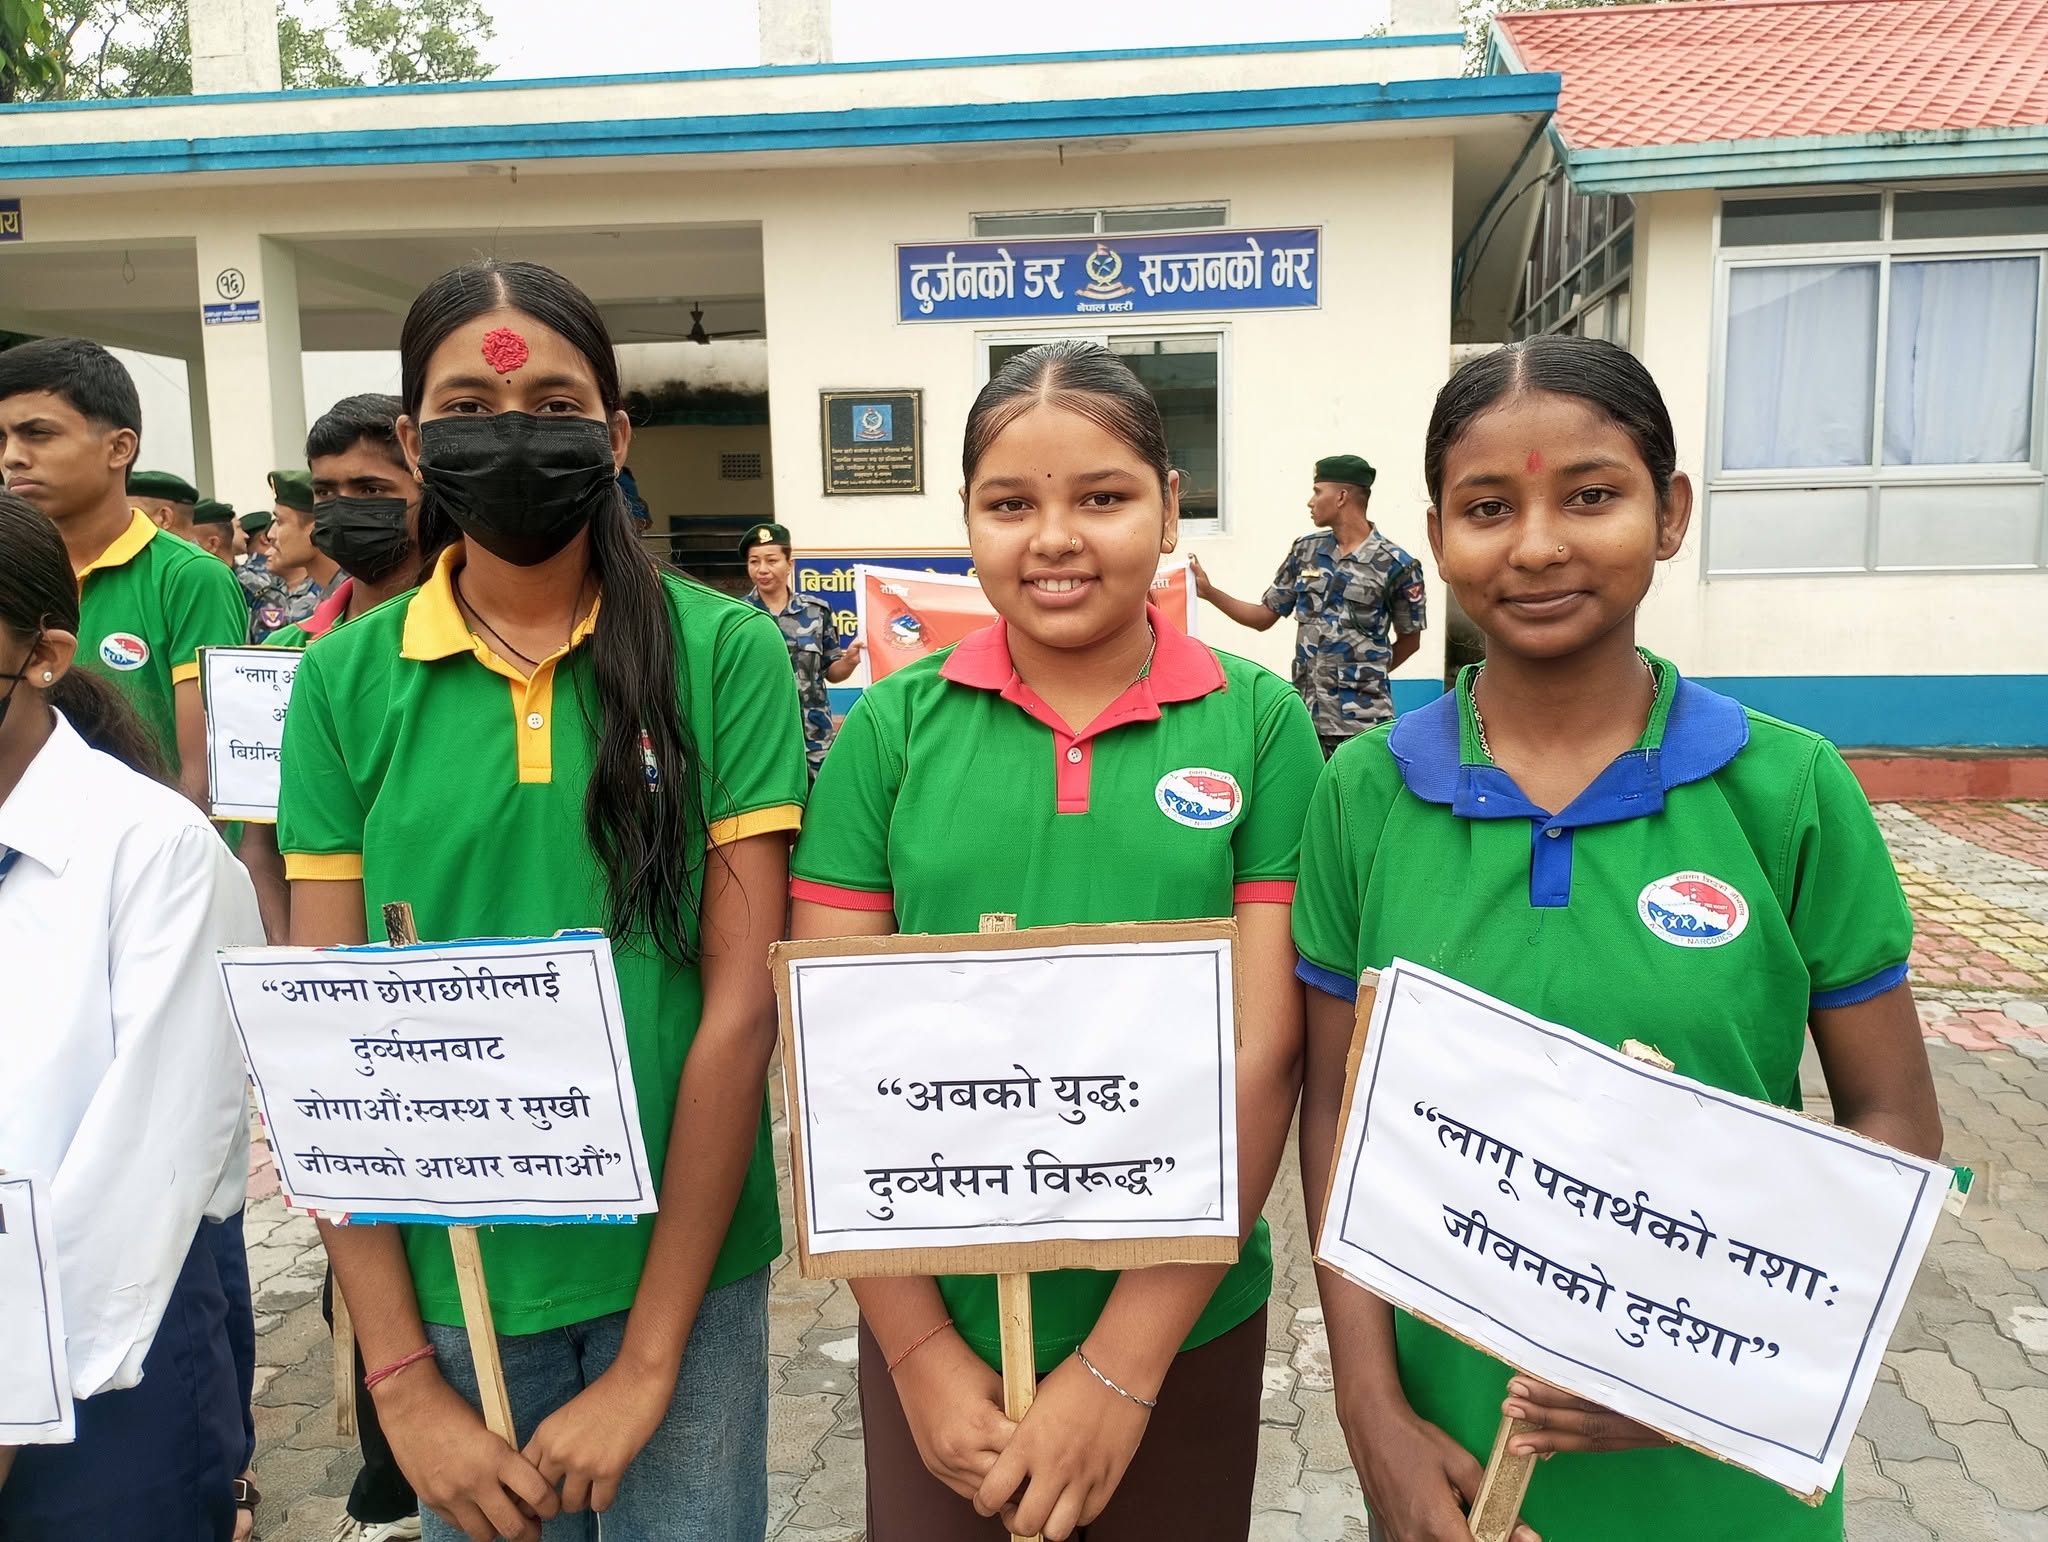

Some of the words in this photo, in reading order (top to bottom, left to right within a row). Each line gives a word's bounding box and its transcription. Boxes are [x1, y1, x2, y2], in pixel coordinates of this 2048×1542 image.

[910, 248, 1016, 314] दुर्जनको
[1023, 258, 1066, 300] डर
[1139, 237, 1264, 297] सज्जनको
[1271, 248, 1315, 290] भर
[1076, 302, 1106, 313] नेपाल
[1108, 300, 1134, 313] प्रहरी
[1686, 931, 1735, 945] NARCOTICS
[372, 960, 561, 1004] छोराछोरीलाई
[349, 1028, 505, 1077] दुर्व्यसनबाट
[495, 1098, 515, 1121] र
[517, 1086, 591, 1131] सुखी
[294, 1146, 407, 1177] जीवनको
[415, 1156, 505, 1179] आधार
[863, 1152, 1014, 1222] दुर्व्यसन
[1532, 1158, 1718, 1260] पदार्थको
[1442, 1203, 1616, 1313] जीवनको
